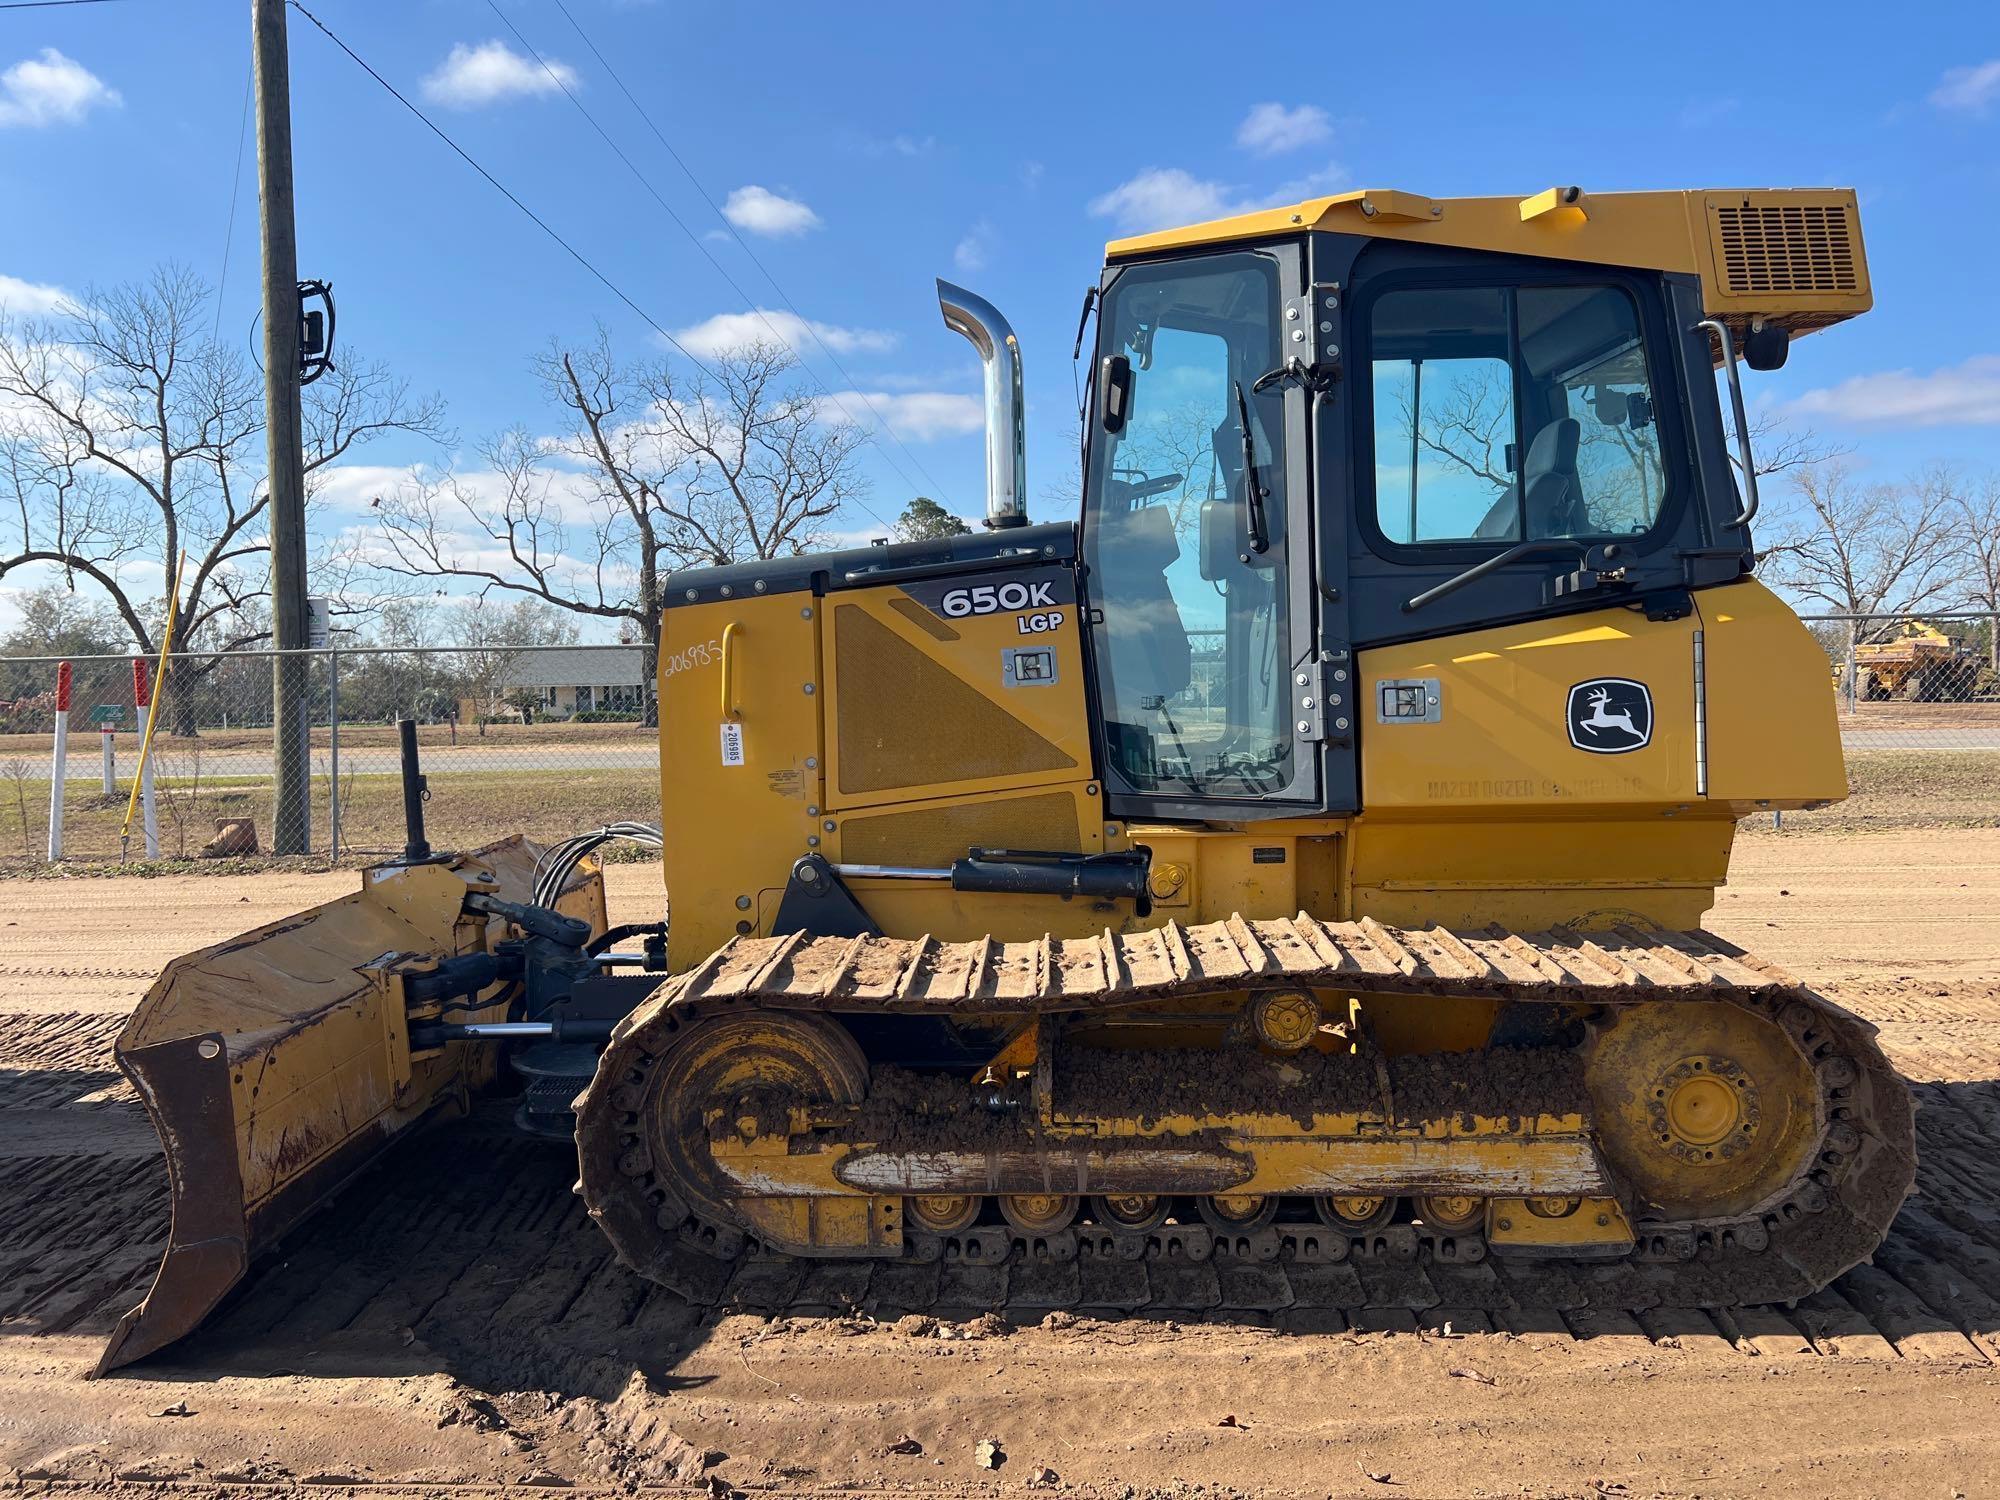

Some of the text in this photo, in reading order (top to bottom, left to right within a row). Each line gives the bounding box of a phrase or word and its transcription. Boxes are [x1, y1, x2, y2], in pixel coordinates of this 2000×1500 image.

[942, 581, 1057, 617] 650K
[1017, 612, 1064, 634] LGP
[664, 640, 724, 677] 206985
[727, 732, 740, 761] 206985
